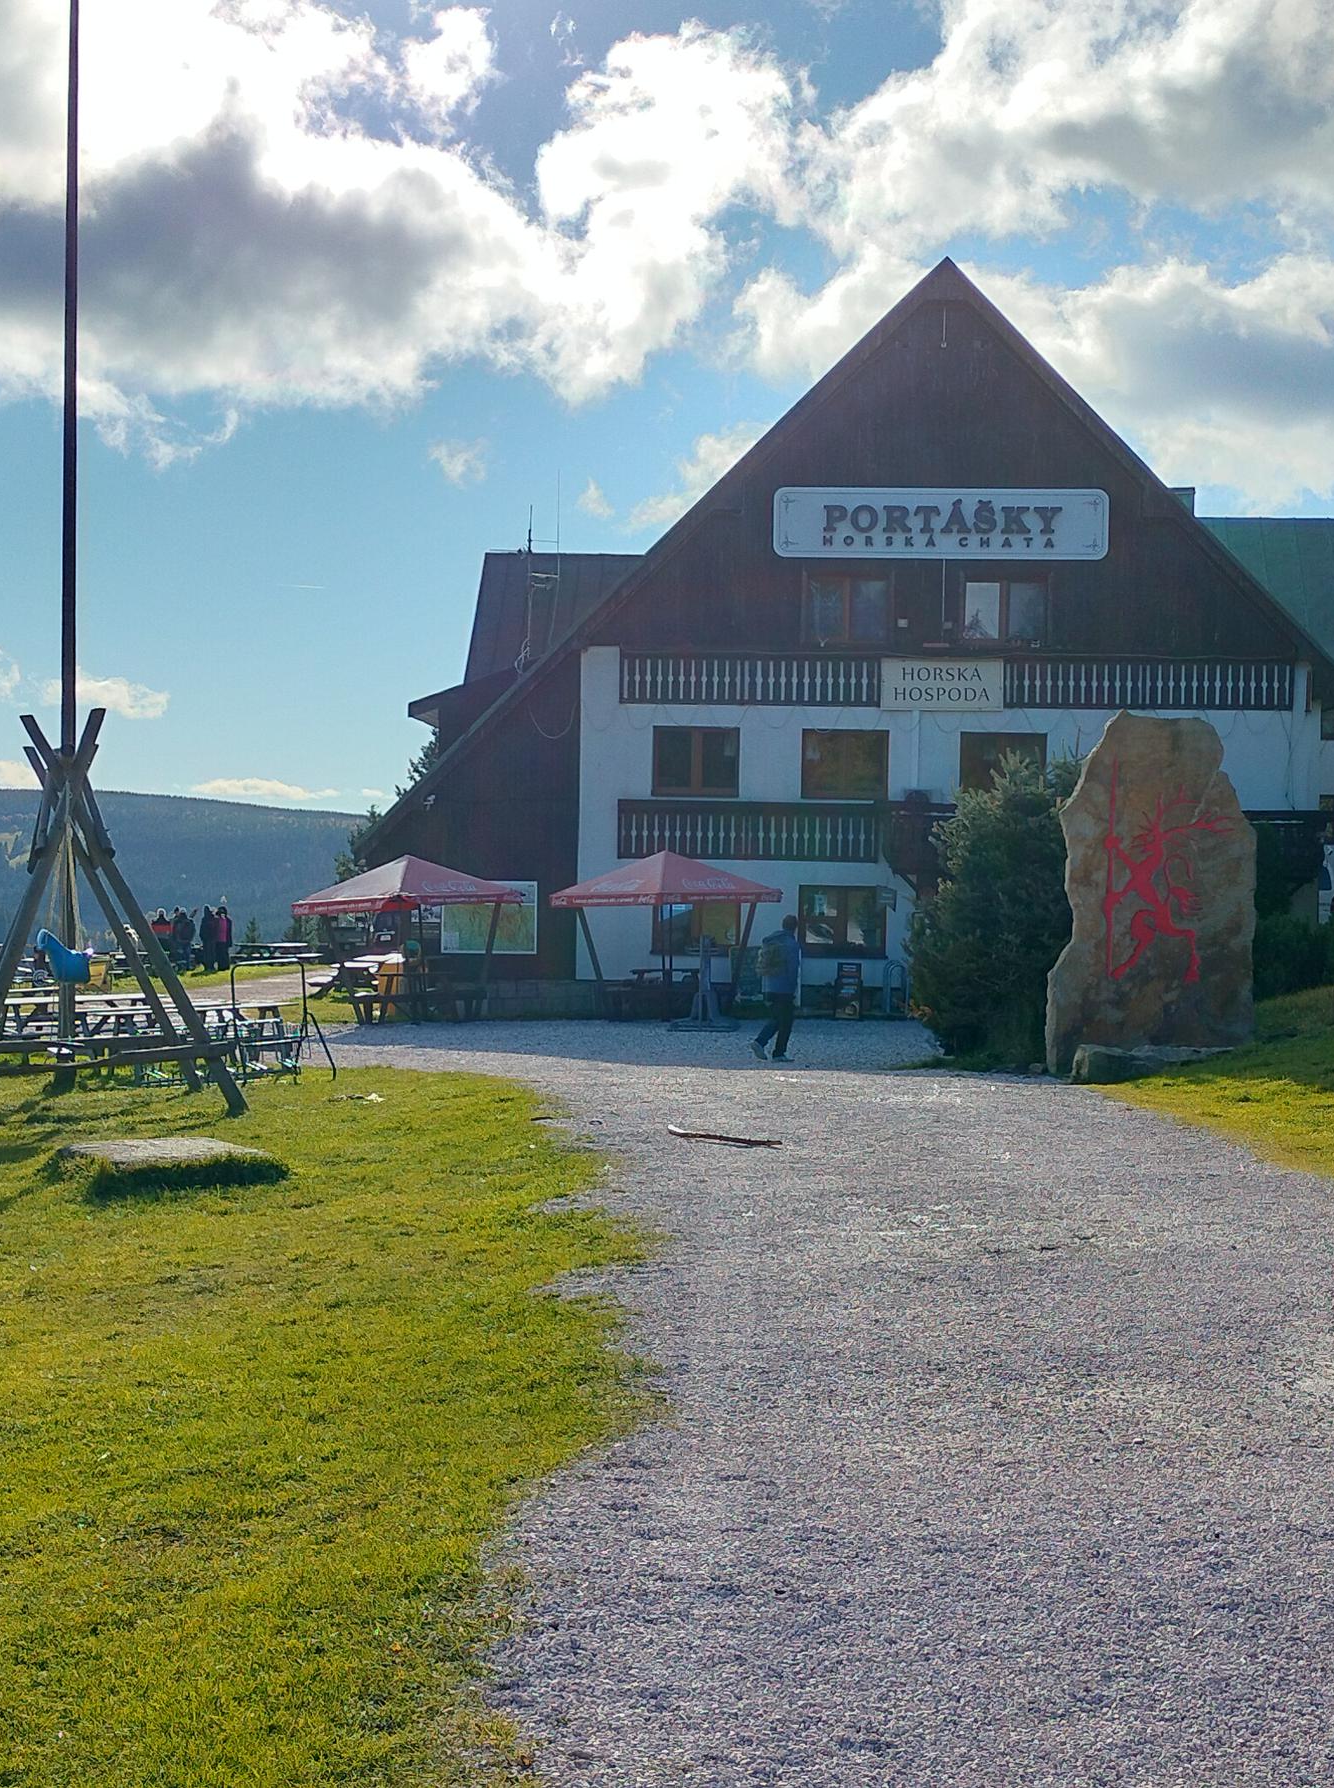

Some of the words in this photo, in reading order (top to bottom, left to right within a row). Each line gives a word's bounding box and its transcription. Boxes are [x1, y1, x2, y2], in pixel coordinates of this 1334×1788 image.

[823, 498, 1062, 534] PORTÁŠKY
[823, 534, 936, 548] HORSKÁ
[958, 537, 1055, 549] CHATA
[902, 665, 983, 682] HORSKÁ
[894, 687, 990, 702] HOSPODA
